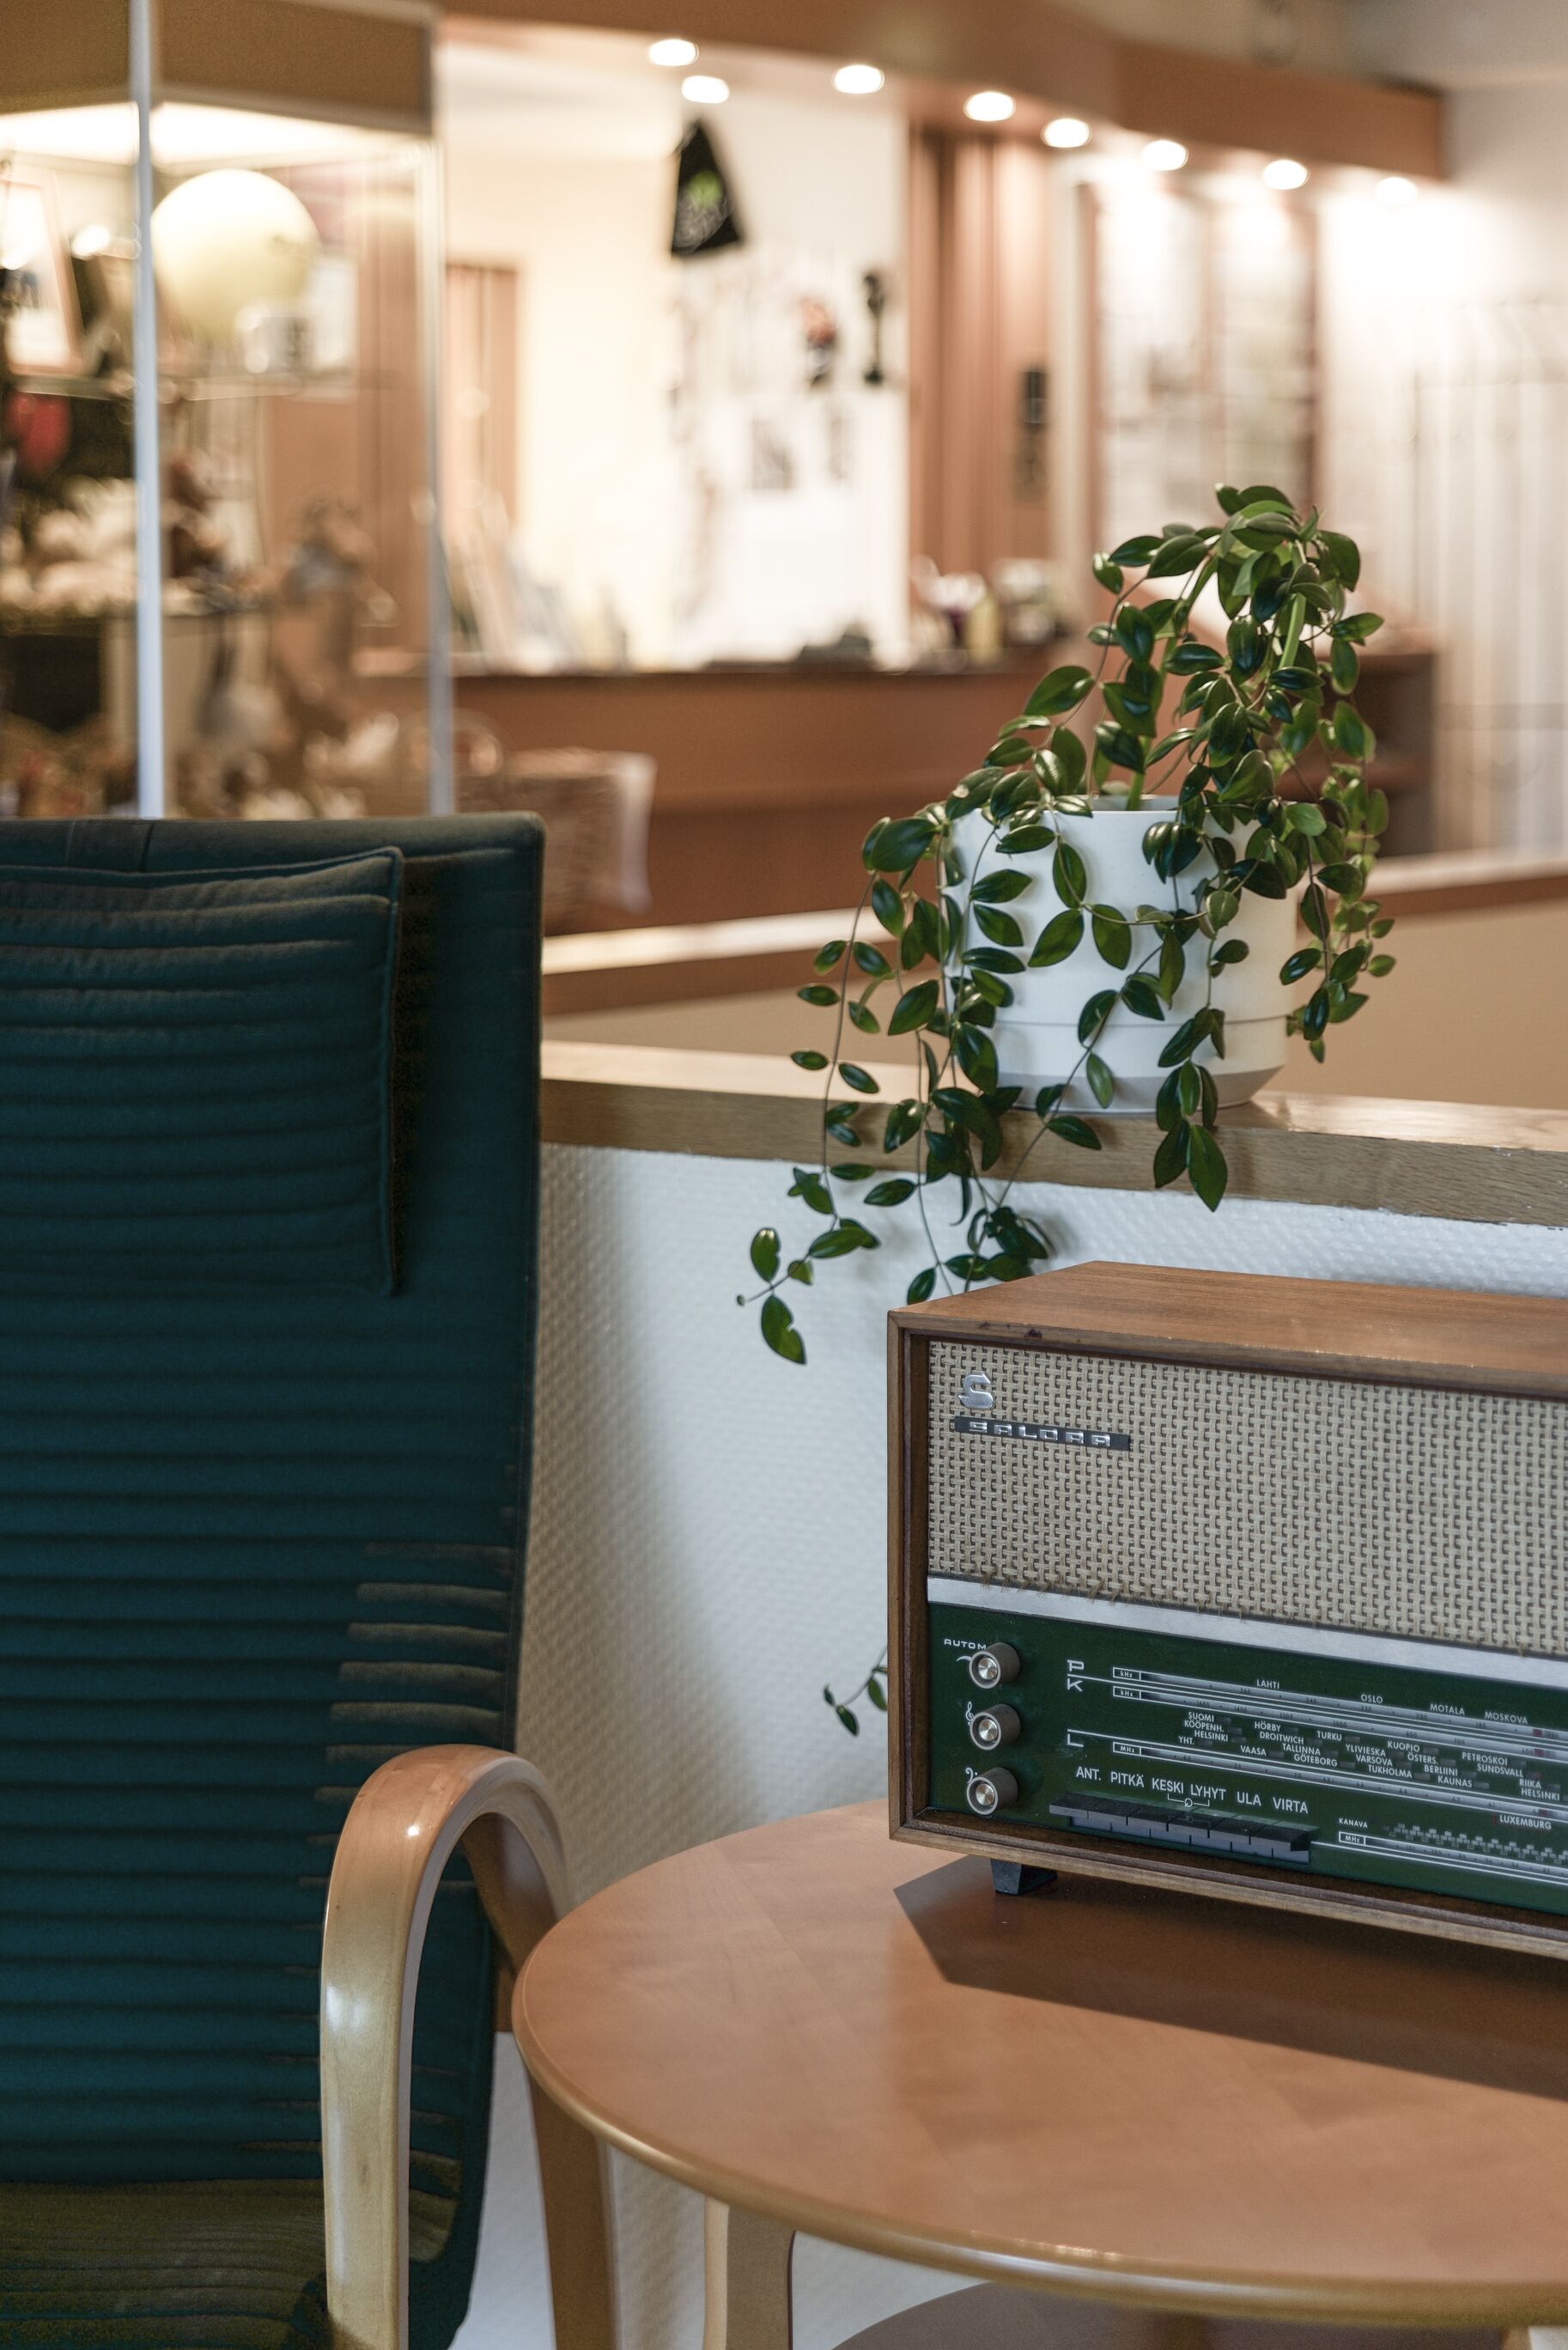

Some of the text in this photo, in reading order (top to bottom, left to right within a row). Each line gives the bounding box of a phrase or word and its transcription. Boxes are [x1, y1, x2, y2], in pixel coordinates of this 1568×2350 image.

[957, 1371, 994, 1409] S
[969, 1422, 1111, 1447] SALORA
[1067, 1659, 1085, 1671] P
[1120, 1670, 1133, 1678] kHz
[1067, 1678, 1083, 1691] K
[1256, 1679, 1279, 1689] LAHTI
[1360, 1694, 1383, 1704] OSLO
[1430, 1703, 1465, 1715] MOTALA
[1188, 1711, 1214, 1723] SUOMI
[1484, 1711, 1528, 1726] MOSKOVA
[1184, 1720, 1225, 1732] KÖÖPENH.
[1254, 1720, 1281, 1732] HÖRBY
[1067, 1734, 1084, 1747] L
[1178, 1736, 1194, 1745] YHT.
[1194, 1730, 1229, 1742] HELSINKI
[1260, 1731, 1304, 1744] DROITWICH
[1316, 1730, 1342, 1741] TURKU
[1240, 1744, 1267, 1756] VAASA
[1282, 1743, 1321, 1756] TALLINNA
[1346, 1744, 1386, 1757] YLIVIESKA
[1388, 1740, 1420, 1752] KUOPIO
[1293, 1753, 1338, 1767] GÖTEBORG
[1356, 1754, 1393, 1767] VARSOVA
[1407, 1752, 1439, 1765] ÖSTERS.
[1462, 1751, 1508, 1766] PETROSKOI
[1368, 1764, 1413, 1779] TUKHOLMA
[1424, 1764, 1458, 1777] BERLIINI
[1477, 1762, 1524, 1778] SUNDSVALL
[1437, 1775, 1473, 1787] KAUNAS
[1519, 1778, 1542, 1789] RIIKA
[1076, 1766, 1309, 1814] ANT. PITKÄ KESKI LYHYT ULA VIRTA
[1521, 1787, 1560, 1801] HELSINKI
[1339, 1817, 1368, 1829] KANAVA
[1499, 1814, 1552, 1829] LUXEMBURG
[1345, 1835, 1361, 1843] MHz
